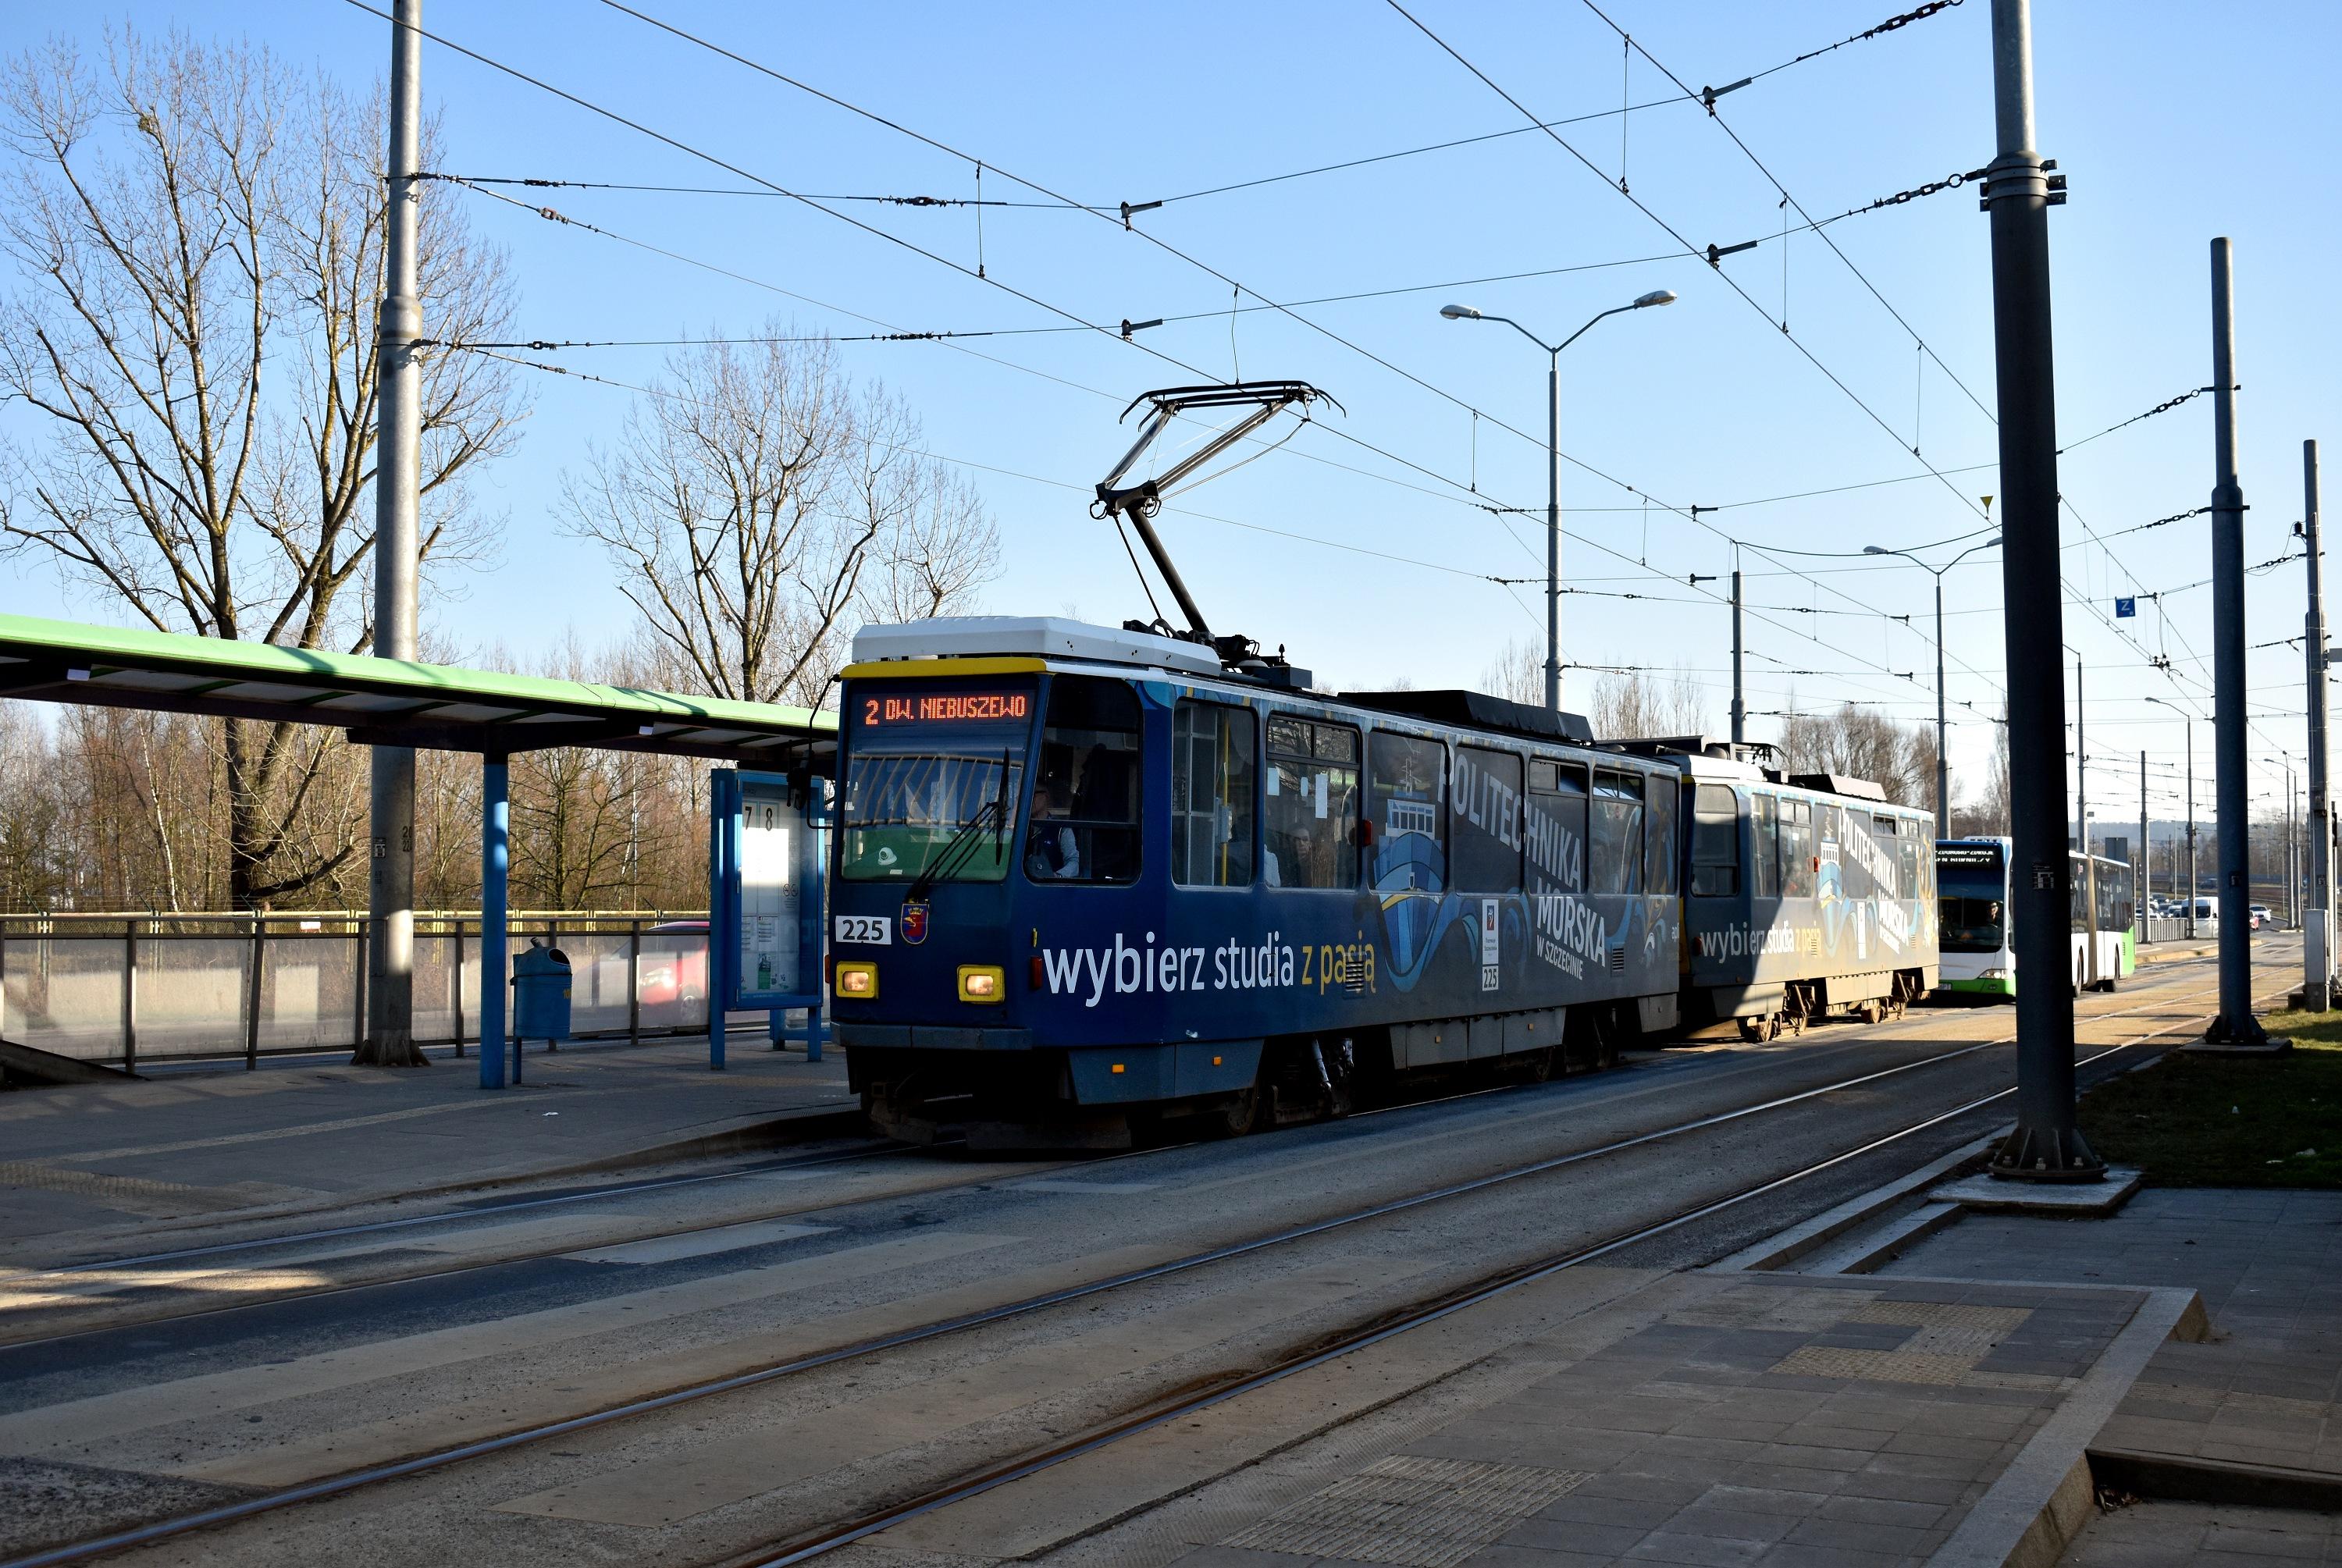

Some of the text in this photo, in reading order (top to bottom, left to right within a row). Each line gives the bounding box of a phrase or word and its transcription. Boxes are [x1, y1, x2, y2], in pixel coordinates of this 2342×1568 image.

[2120, 600, 2130, 611] Z
[865, 695, 1025, 725] 2 DW. NIEBUSZEWO
[745, 805, 752, 830] 7
[765, 807, 773, 832] 8
[1437, 745, 1582, 894] POLITECHNIKA
[842, 919, 884, 941] 225
[1536, 876, 1606, 968] MORSKA
[1700, 921, 1767, 964] wybierz
[1767, 919, 1795, 954] studia
[1042, 931, 1205, 1008] wybierz
[1214, 930, 1294, 990] studia
[1301, 944, 1312, 986] z
[1536, 934, 1584, 981] W SZCZECINIE
[1483, 968, 1497, 989] 225
